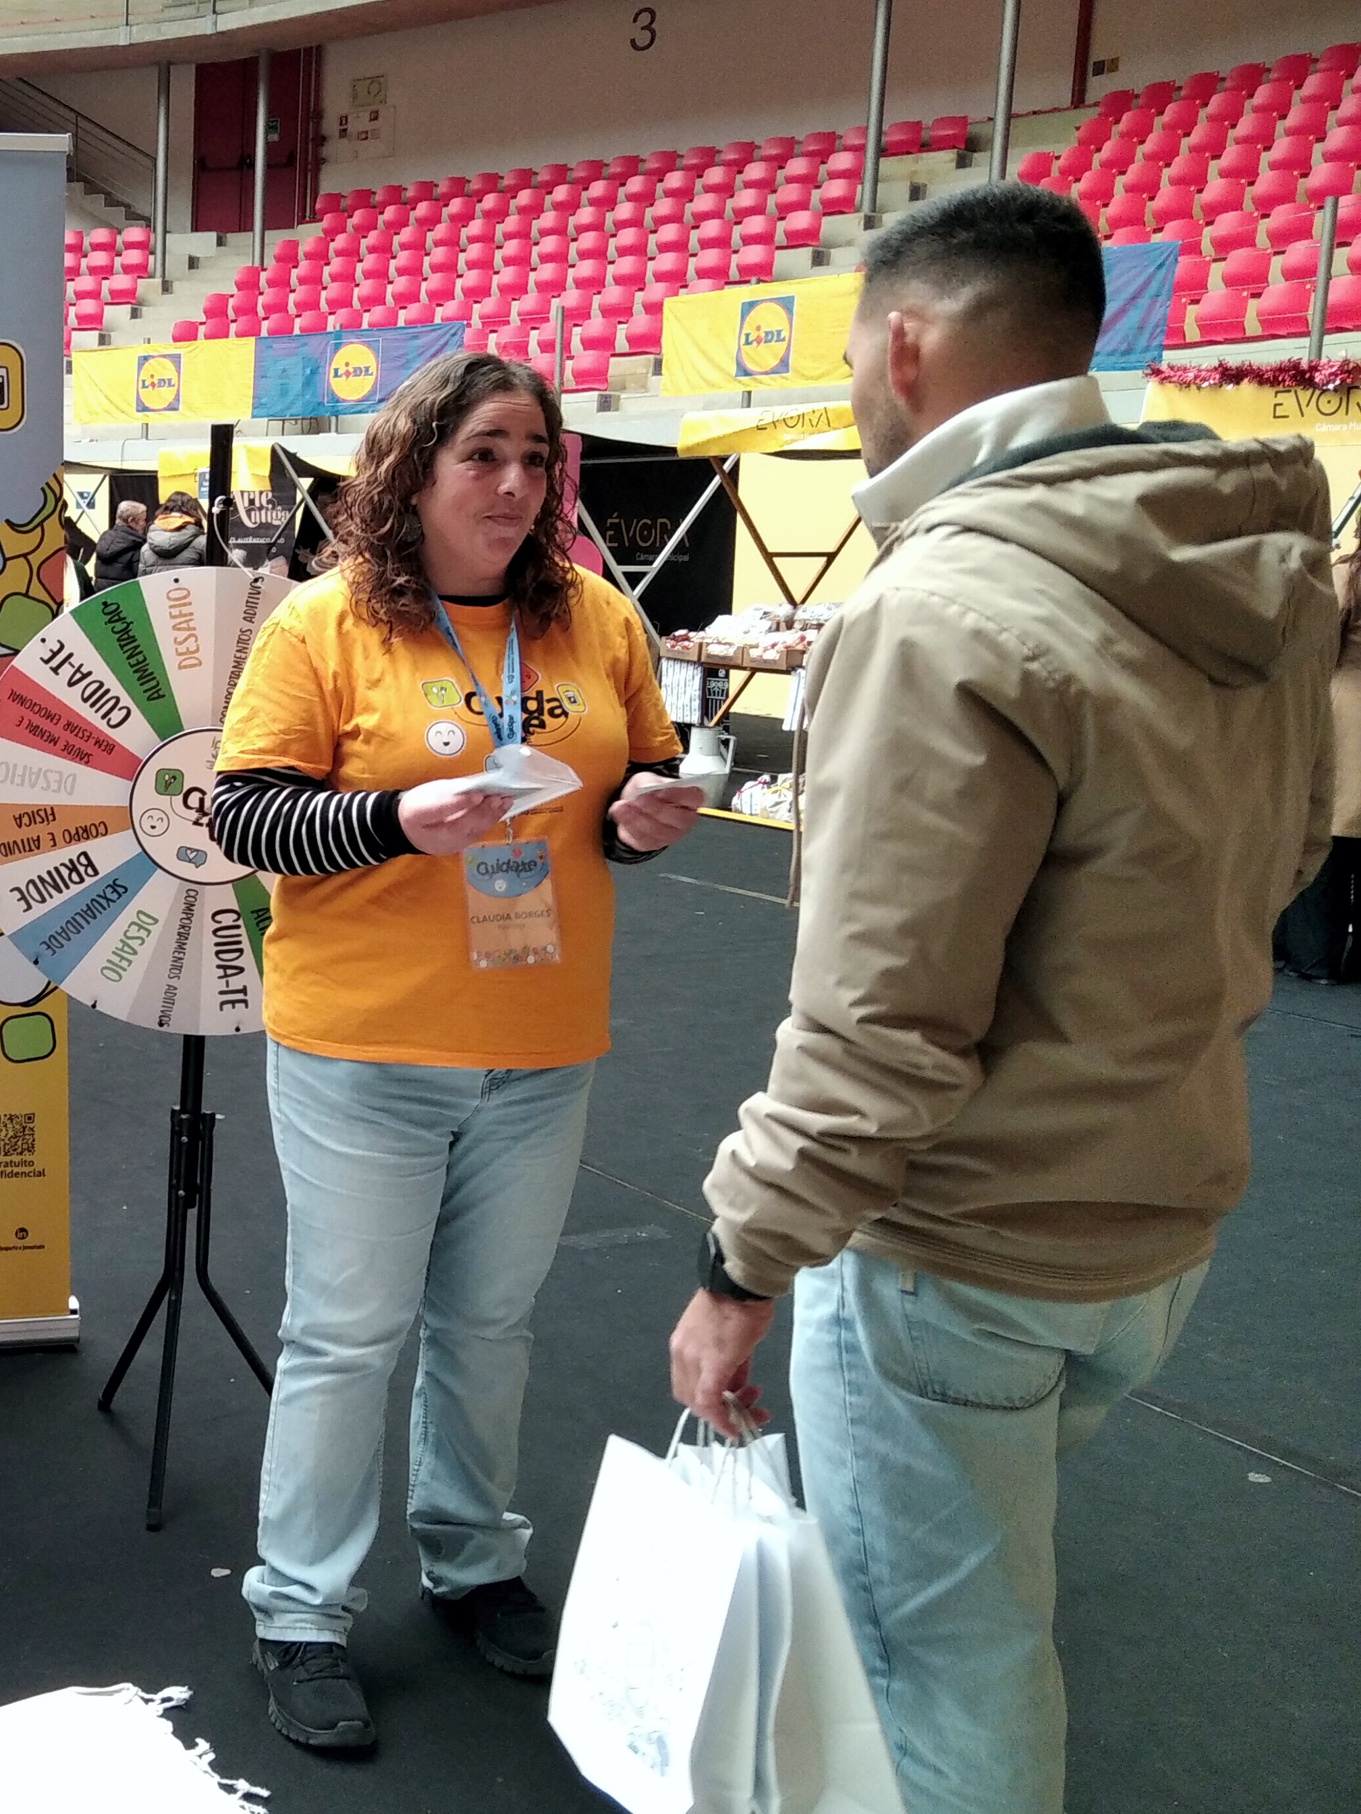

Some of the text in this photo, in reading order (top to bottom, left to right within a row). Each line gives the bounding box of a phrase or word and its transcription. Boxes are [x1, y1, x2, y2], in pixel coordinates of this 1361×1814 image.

[629, 7, 657, 52] 3
[101, 601, 167, 702] ALIMENTAÇÃO
[166, 587, 203, 671] DESAFIO
[40, 638, 132, 729] CUIDA-TE
[7, 688, 116, 756] BEM-ESTAR EMOCIONAL
[15, 716, 94, 764] SAÚDE MENTAL E
[12, 806, 57, 829] FÍSICA
[47, 832, 57, 848] E
[62, 821, 108, 844] CORPO
[9, 851, 100, 912] BRINDE
[39, 877, 128, 956] SEXUALIDADE
[100, 909, 160, 983] DESAFIO
[167, 888, 199, 980] COMPORTAMENTOS
[210, 908, 249, 1012] CUIDA-TE
